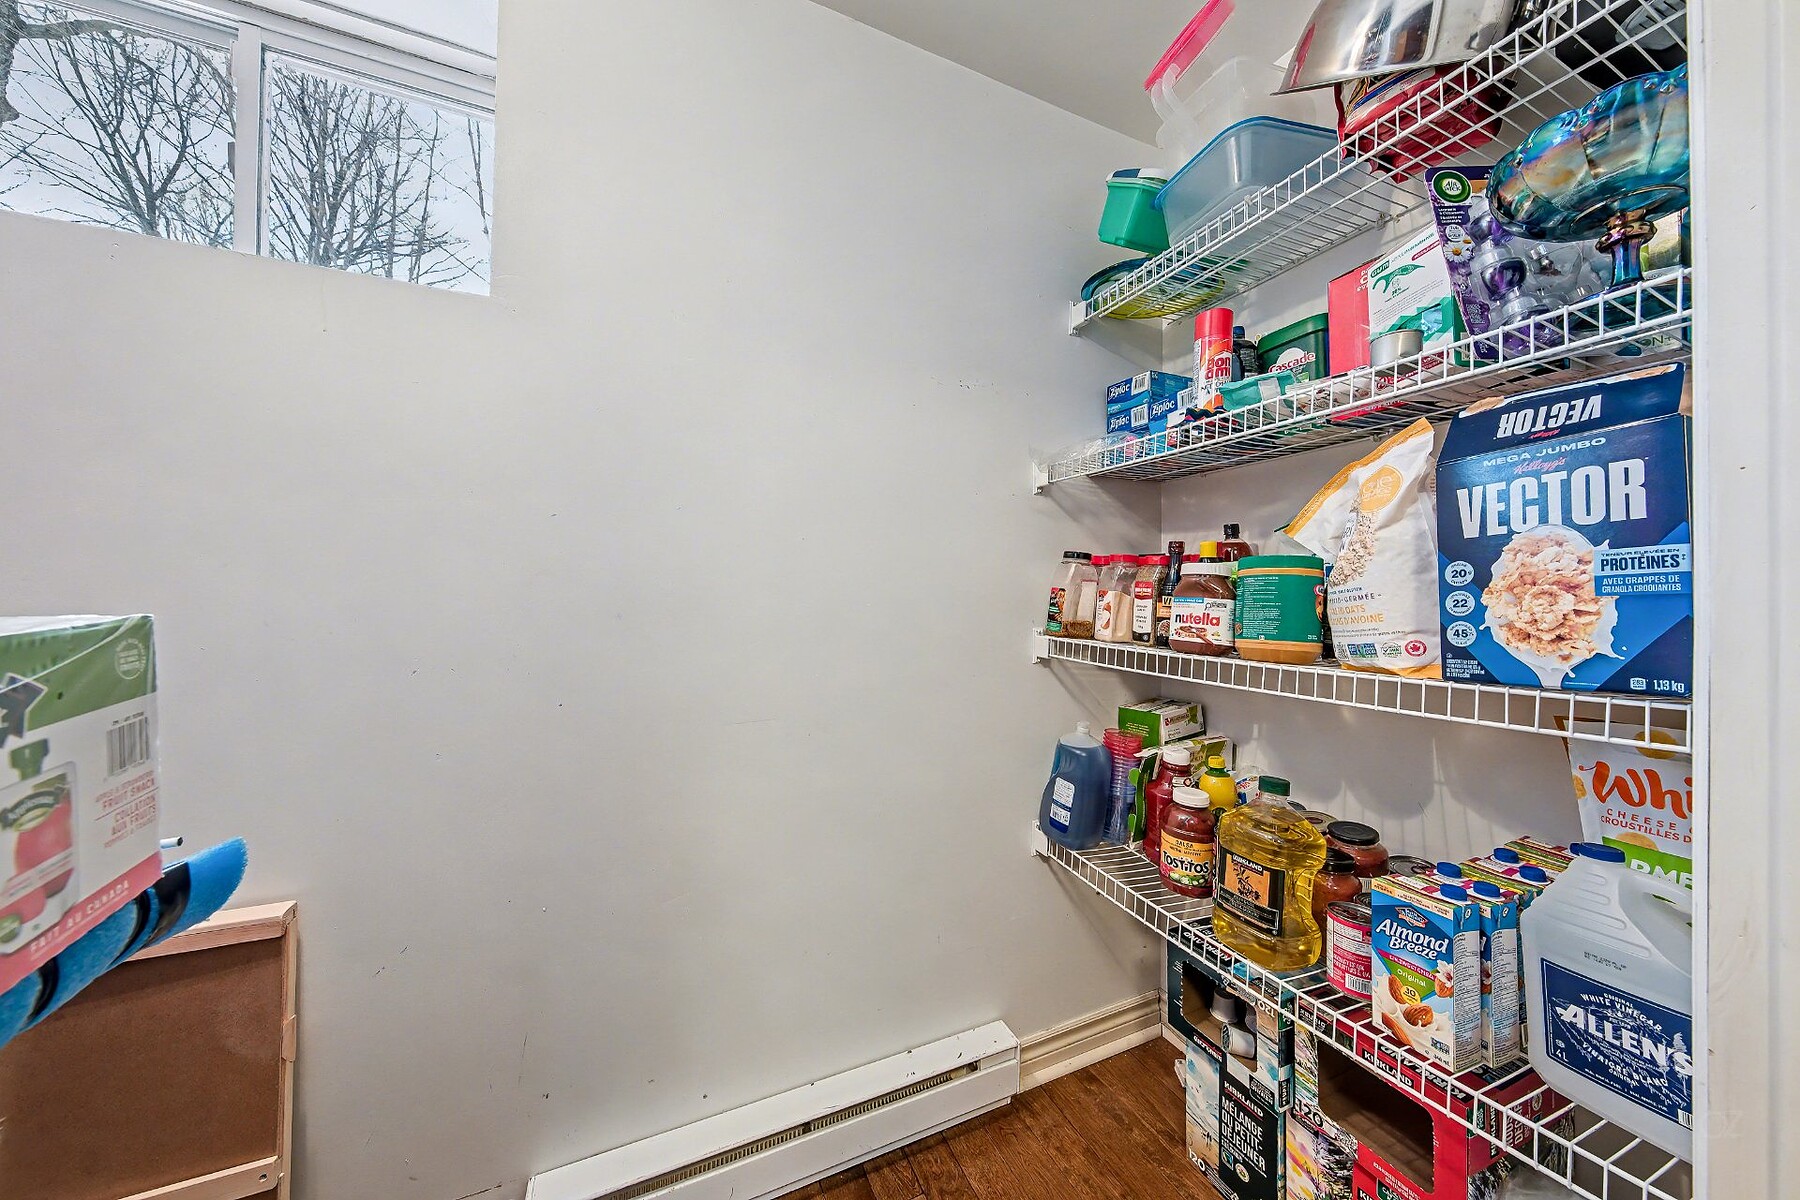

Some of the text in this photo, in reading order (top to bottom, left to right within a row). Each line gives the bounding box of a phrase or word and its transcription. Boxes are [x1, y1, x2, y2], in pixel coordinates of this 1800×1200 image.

[1268, 351, 1316, 374] Cascade
[1151, 400, 1176, 418] Ziploc
[1497, 394, 1602, 439] VECTOR
[1483, 437, 1607, 467] MEGA JUMBO
[1456, 458, 1648, 538] VECTOR
[1451, 569, 1467, 579] 20
[1600, 553, 1680, 572] PROTÉINES
[1602, 583, 1682, 593] GRANOLA CROQUANTES
[1603, 574, 1680, 585] AVEC GRAPPES DE
[1453, 599, 1468, 608] 22
[1175, 612, 1221, 627] nutella
[1671, 681, 1685, 693] kg
[1600, 815, 1680, 841] CROUSTILLES
[1606, 808, 1677, 831] CHEESE
[1175, 839, 1194, 849] SALSA
[1162, 850, 1210, 874] TOSTITOS
[1375, 918, 1449, 954] Almond
[1389, 936, 1438, 960] Breeze
[1397, 968, 1427, 987] Original
[1404, 987, 1416, 997] 30
[1580, 993, 1662, 1032] WHITE VINEGAR
[1555, 1003, 1693, 1077] ALLEN'S
[1364, 1050, 1413, 1086] KIRKLAND
[1224, 1081, 1264, 1118] KIRKLAND
[1222, 1095, 1263, 1141] MÉLANGE
[1222, 1108, 1234, 1128] DU
[1234, 1120, 1263, 1151] PETIT-
[1221, 1122, 1266, 1172] DÉJEUNER
[1189, 1147, 1206, 1172] 120
